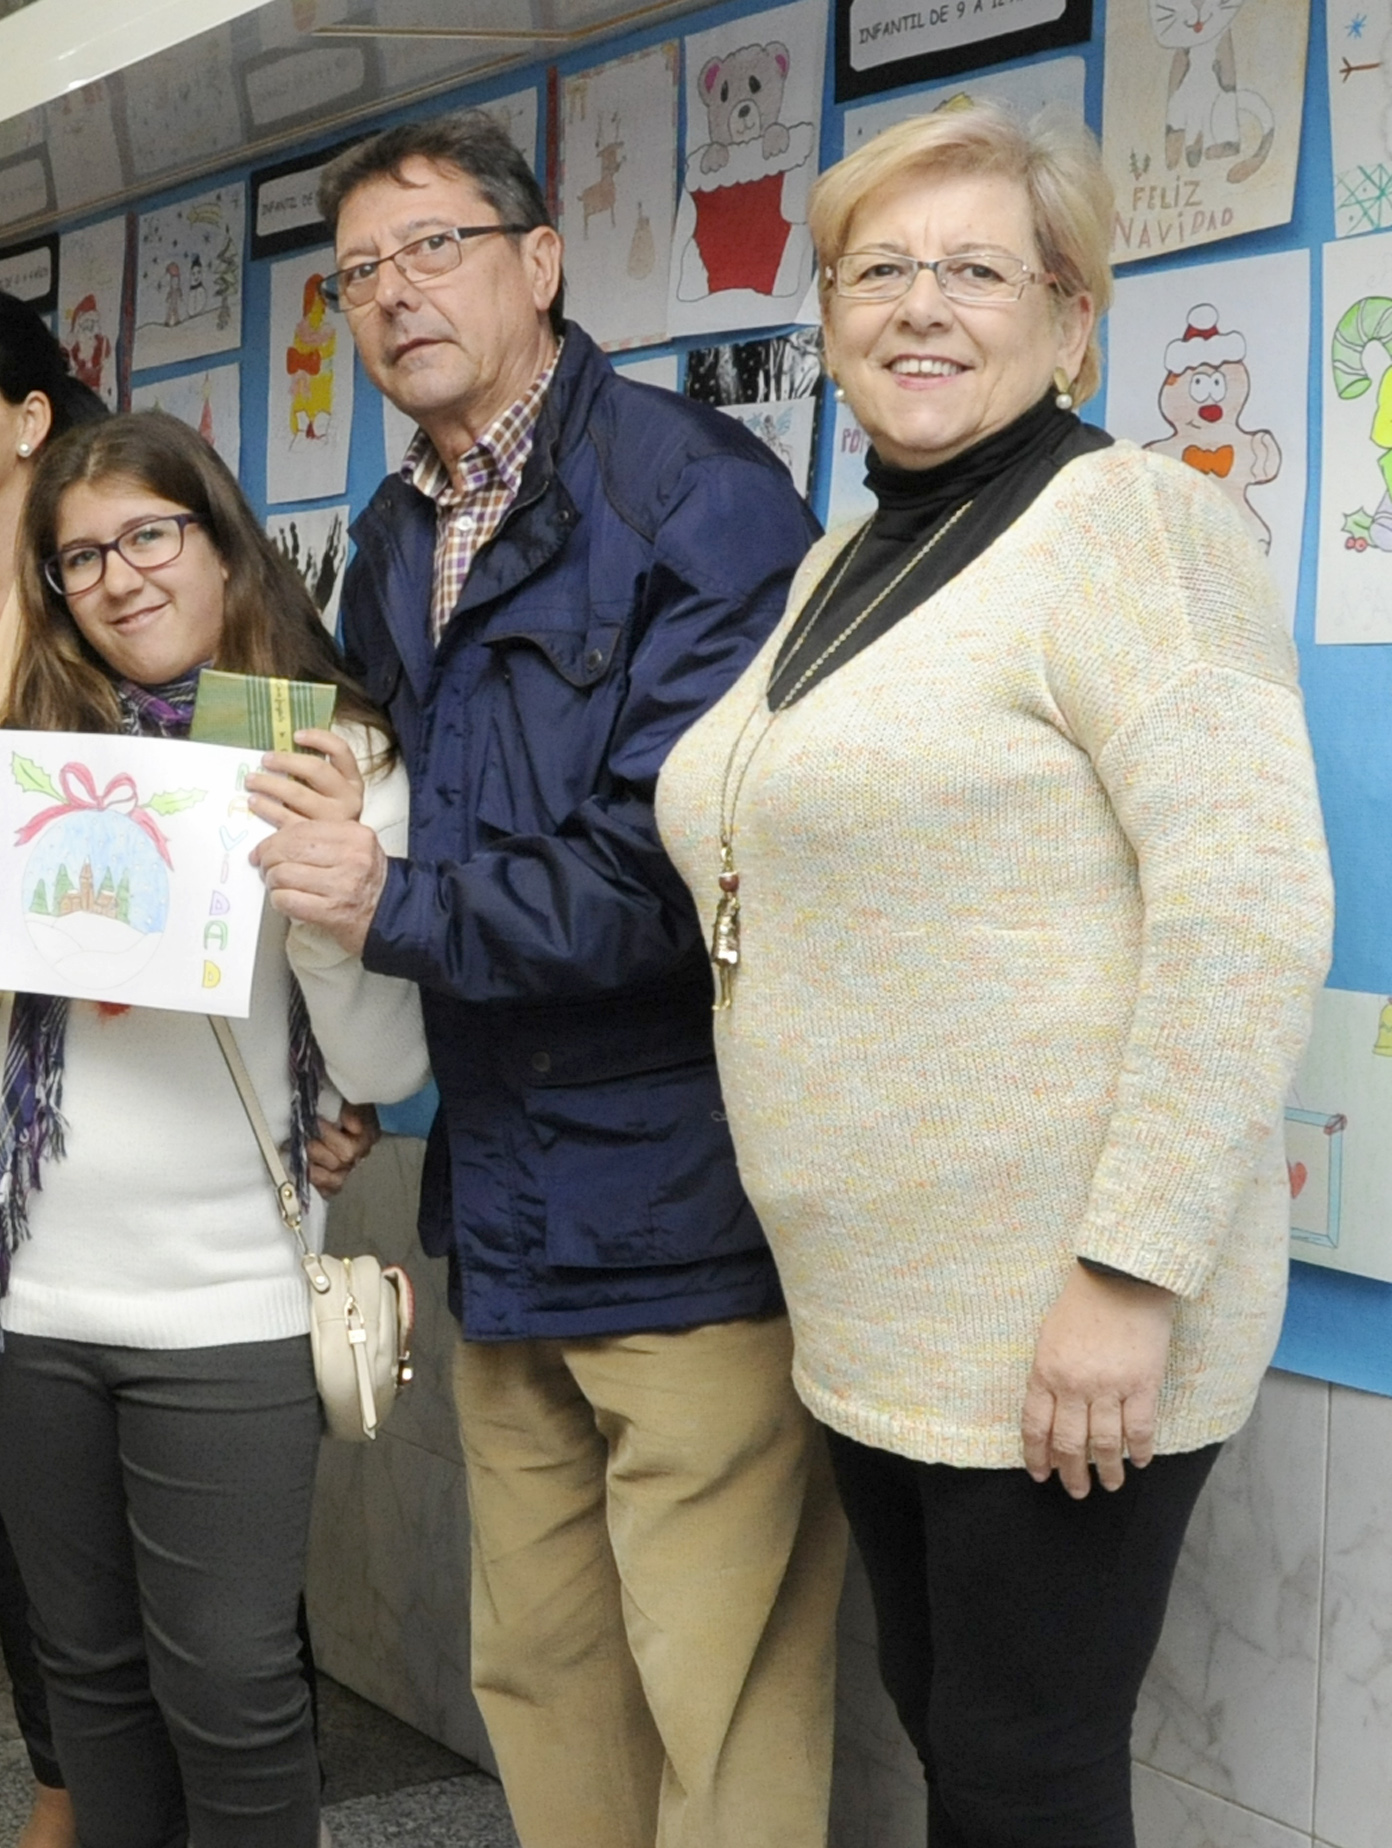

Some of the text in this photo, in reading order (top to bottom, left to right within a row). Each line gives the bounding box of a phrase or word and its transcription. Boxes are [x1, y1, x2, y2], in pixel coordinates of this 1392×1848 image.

[858, 12, 924, 44] INFANTIL
[929, 5, 949, 25] DE
[956, 2, 965, 19] 9
